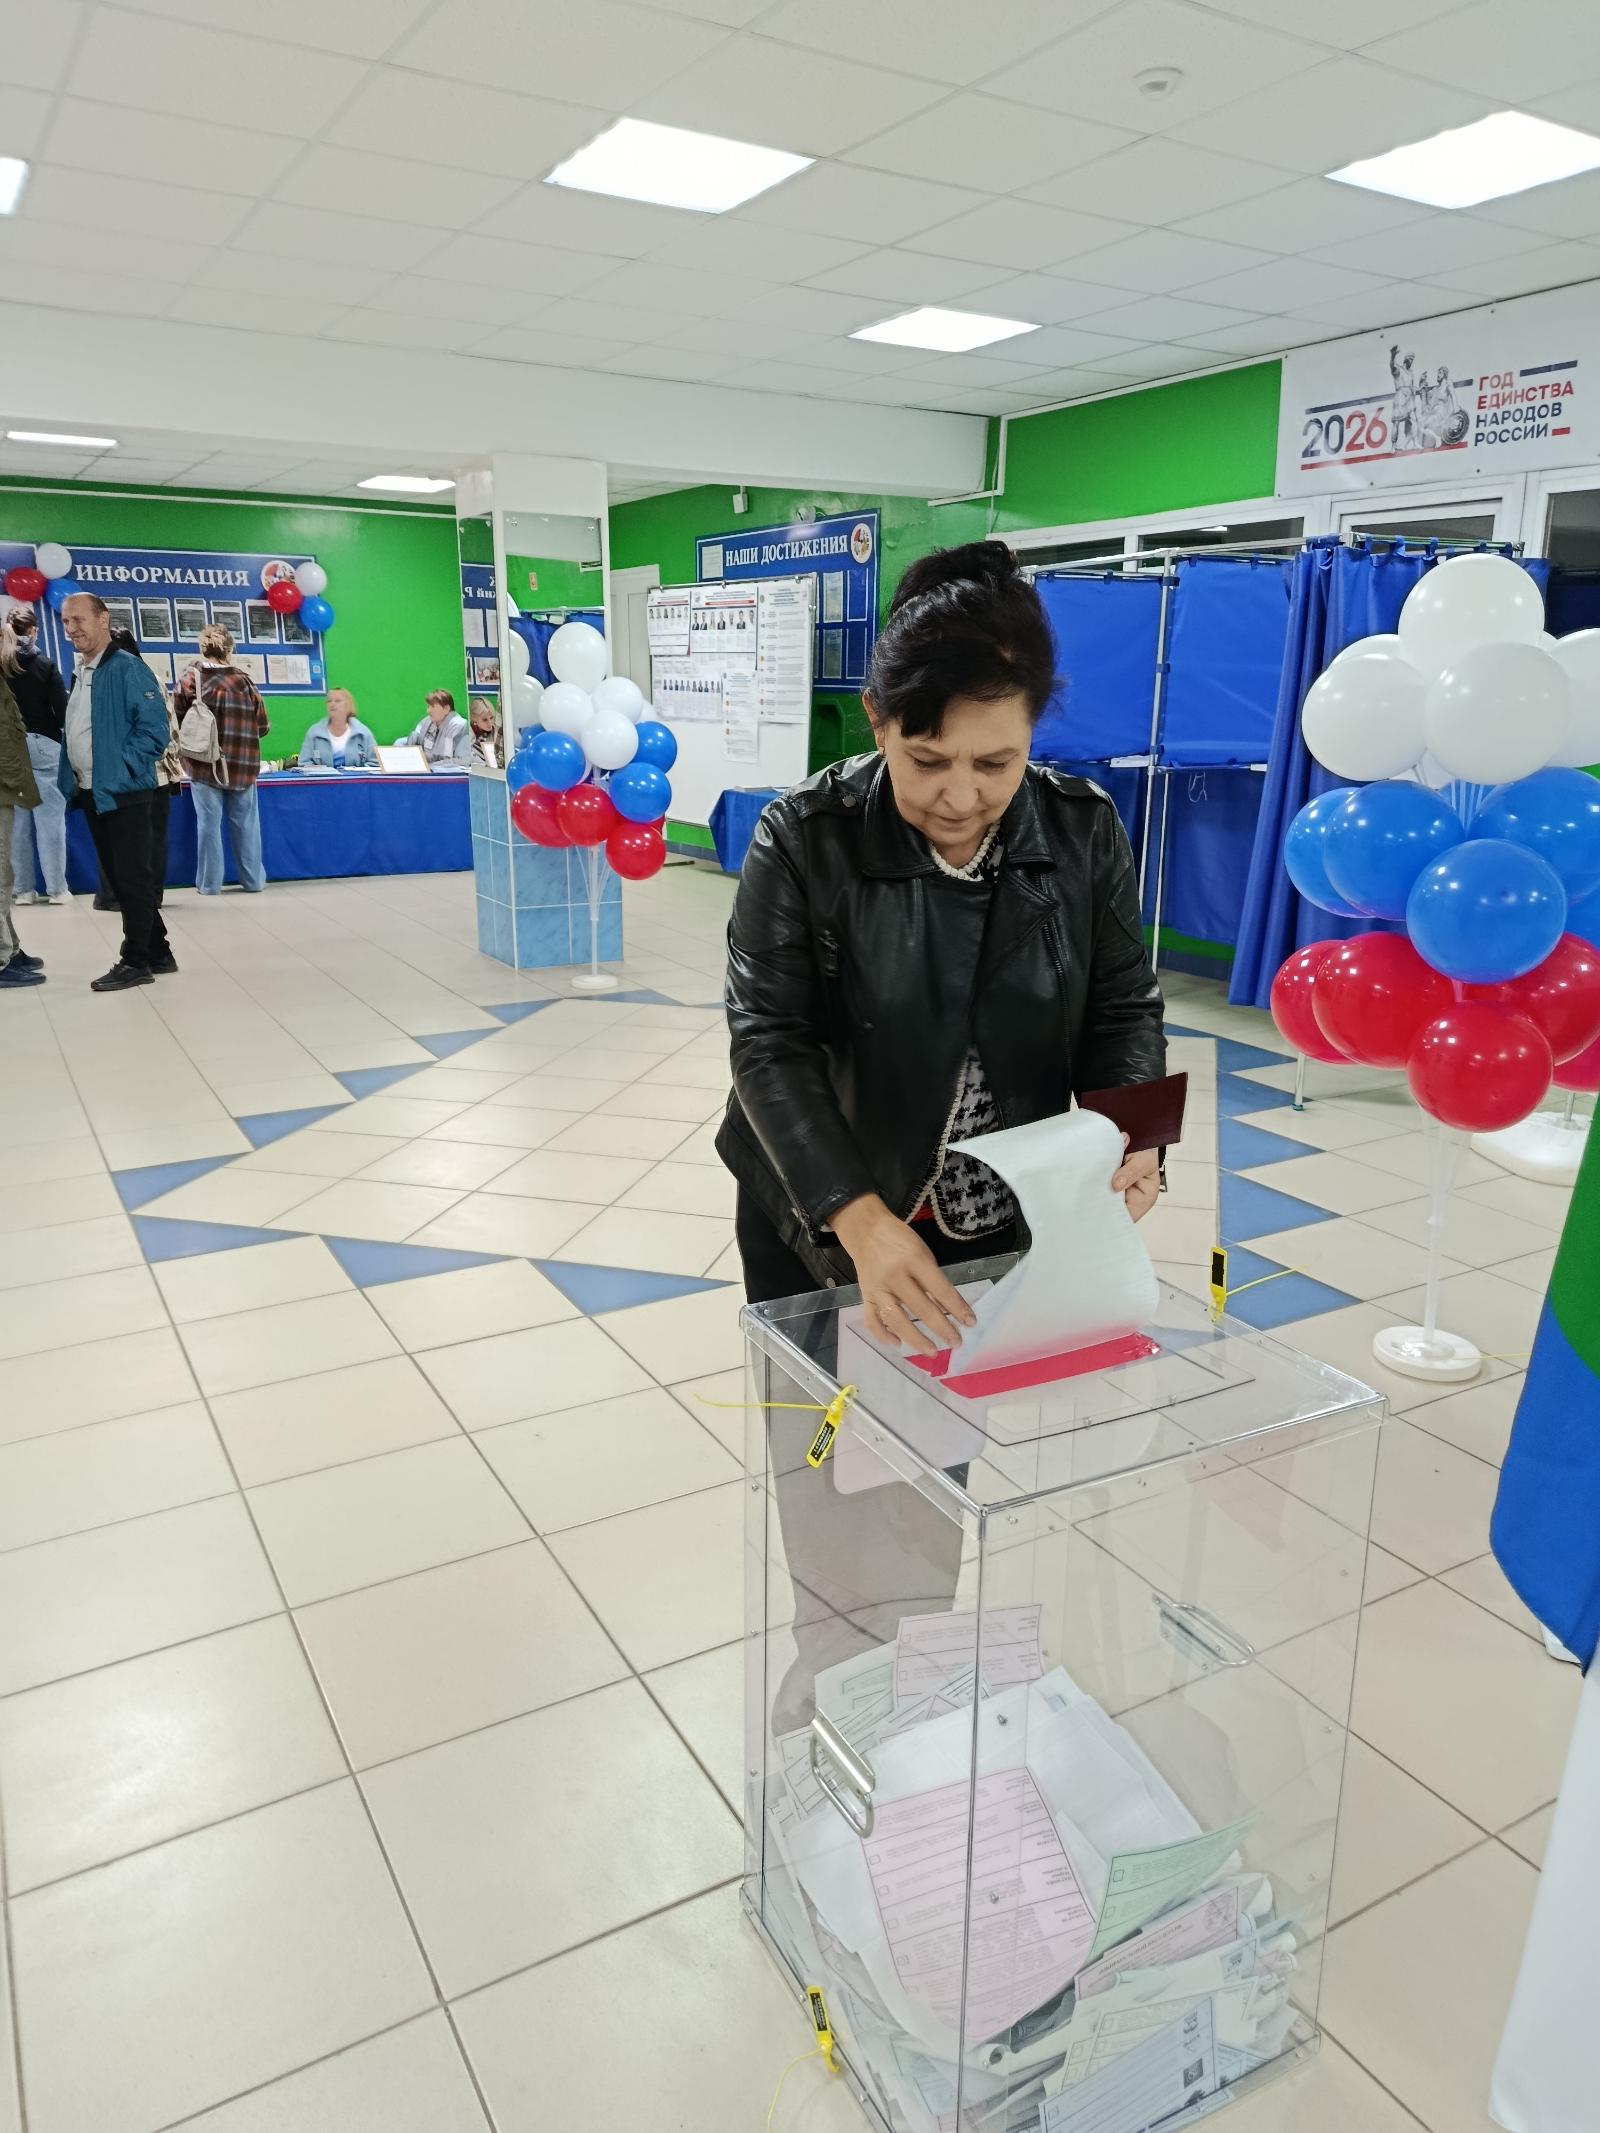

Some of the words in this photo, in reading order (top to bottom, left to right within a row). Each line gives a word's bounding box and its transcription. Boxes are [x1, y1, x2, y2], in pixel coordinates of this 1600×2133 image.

[1479, 371, 1514, 391] ГОД
[1477, 380, 1574, 410] ЕДИНСТВА
[1475, 401, 1563, 428] НАРОДОВ
[1301, 406, 1388, 458] 2026
[1474, 423, 1548, 447] РОССИИ
[725, 547, 758, 567] НАШИ
[761, 534, 848, 565] ДОСТИЖЕНИЯ
[75, 564, 251, 588] ИНФОРМАЦИЯ
